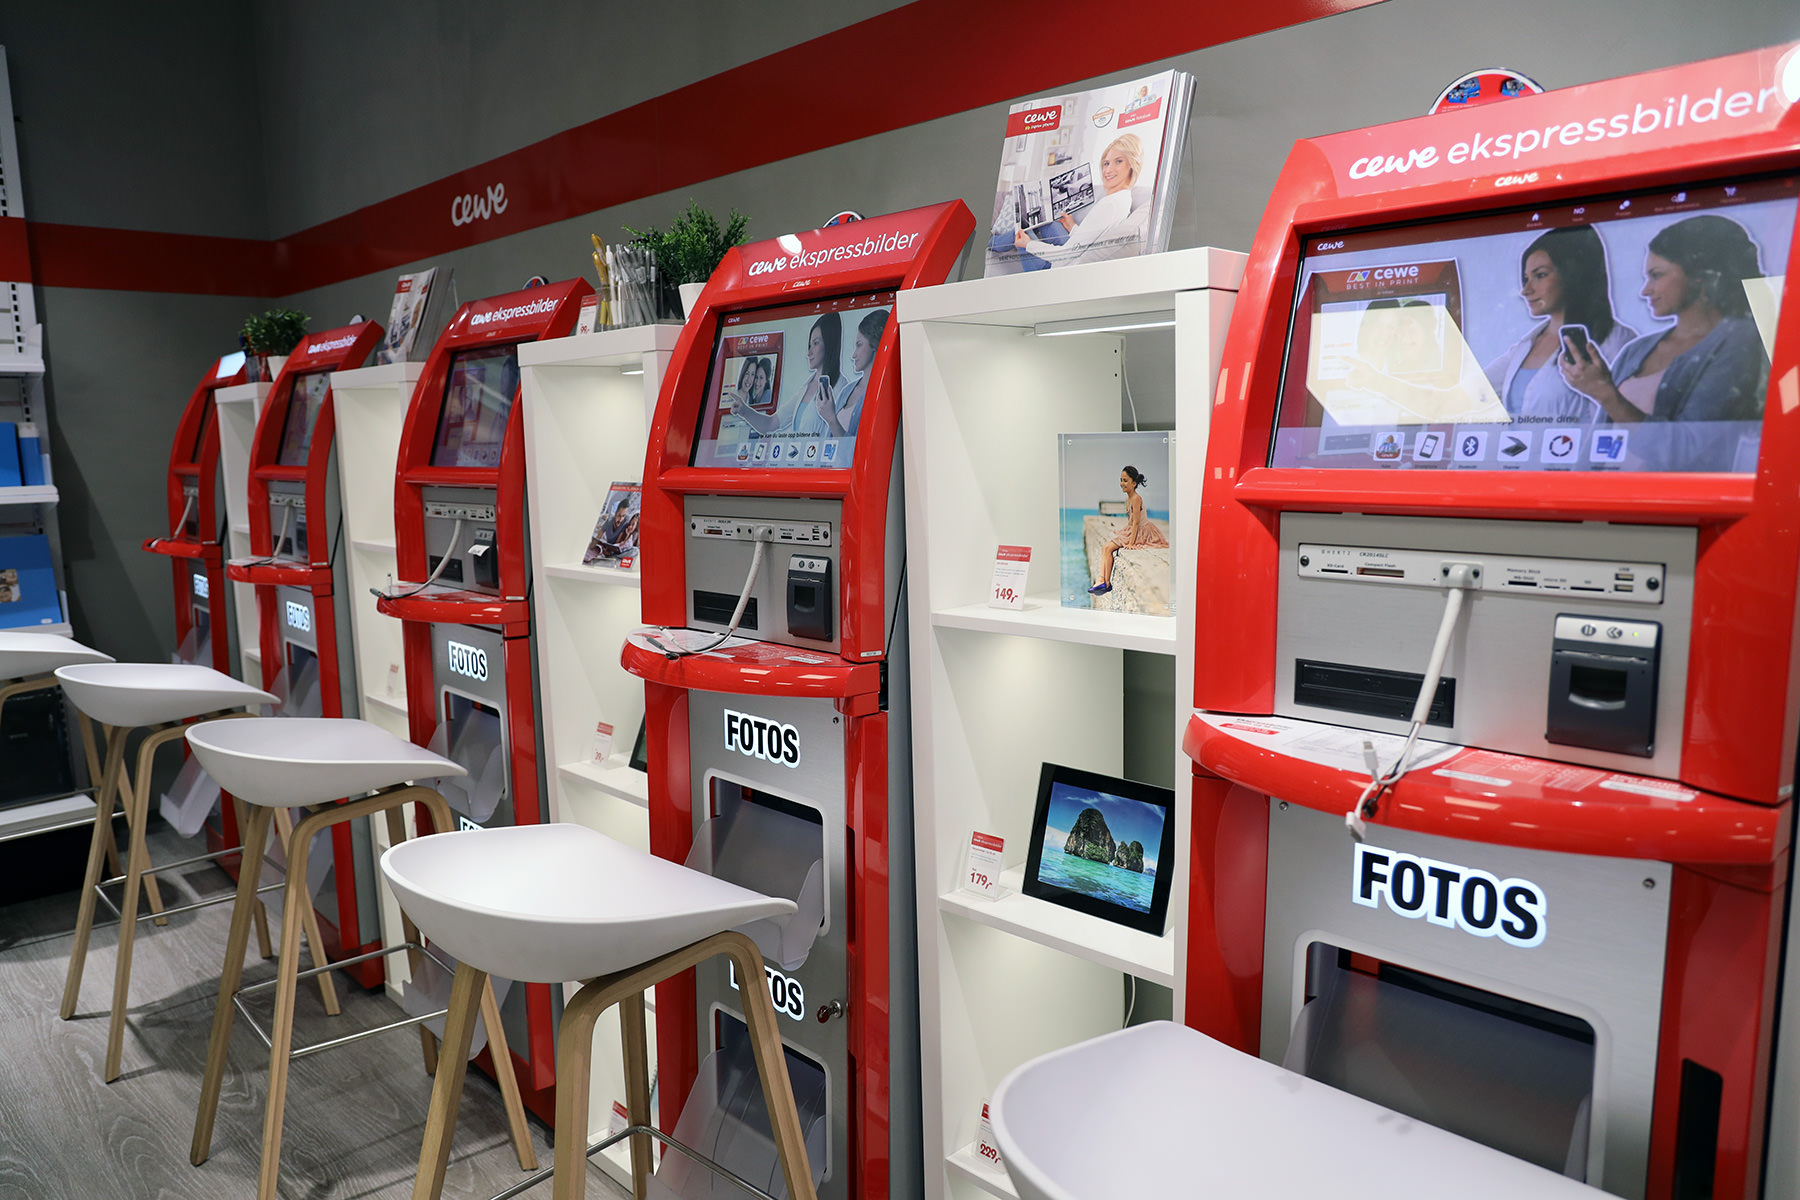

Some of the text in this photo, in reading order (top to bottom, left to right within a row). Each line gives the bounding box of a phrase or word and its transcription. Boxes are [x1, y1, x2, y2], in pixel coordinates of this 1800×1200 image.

[1024, 110, 1057, 124] cewe
[1348, 85, 1779, 180] cewe ekspressbilder
[1494, 172, 1539, 187] cewe
[451, 183, 508, 227] cewe
[1573, 207, 1585, 215] NO
[748, 231, 919, 277] cewe ekspressbilder
[1317, 240, 1345, 251] cewe
[1373, 265, 1420, 280] cewe
[1346, 282, 1370, 290] BEST
[1390, 277, 1419, 286] PRINT
[470, 298, 559, 326] cewe ekspressbilder
[750, 335, 769, 344] cewe
[1517, 415, 1553, 424] bildene
[995, 587, 1018, 603] 149,-
[450, 644, 487, 679] FOTOS
[726, 713, 799, 764] FOTOS
[970, 872, 992, 890] 179,-
[1359, 850, 1539, 941] FOTOS
[980, 1143, 1001, 1164] 229,-
